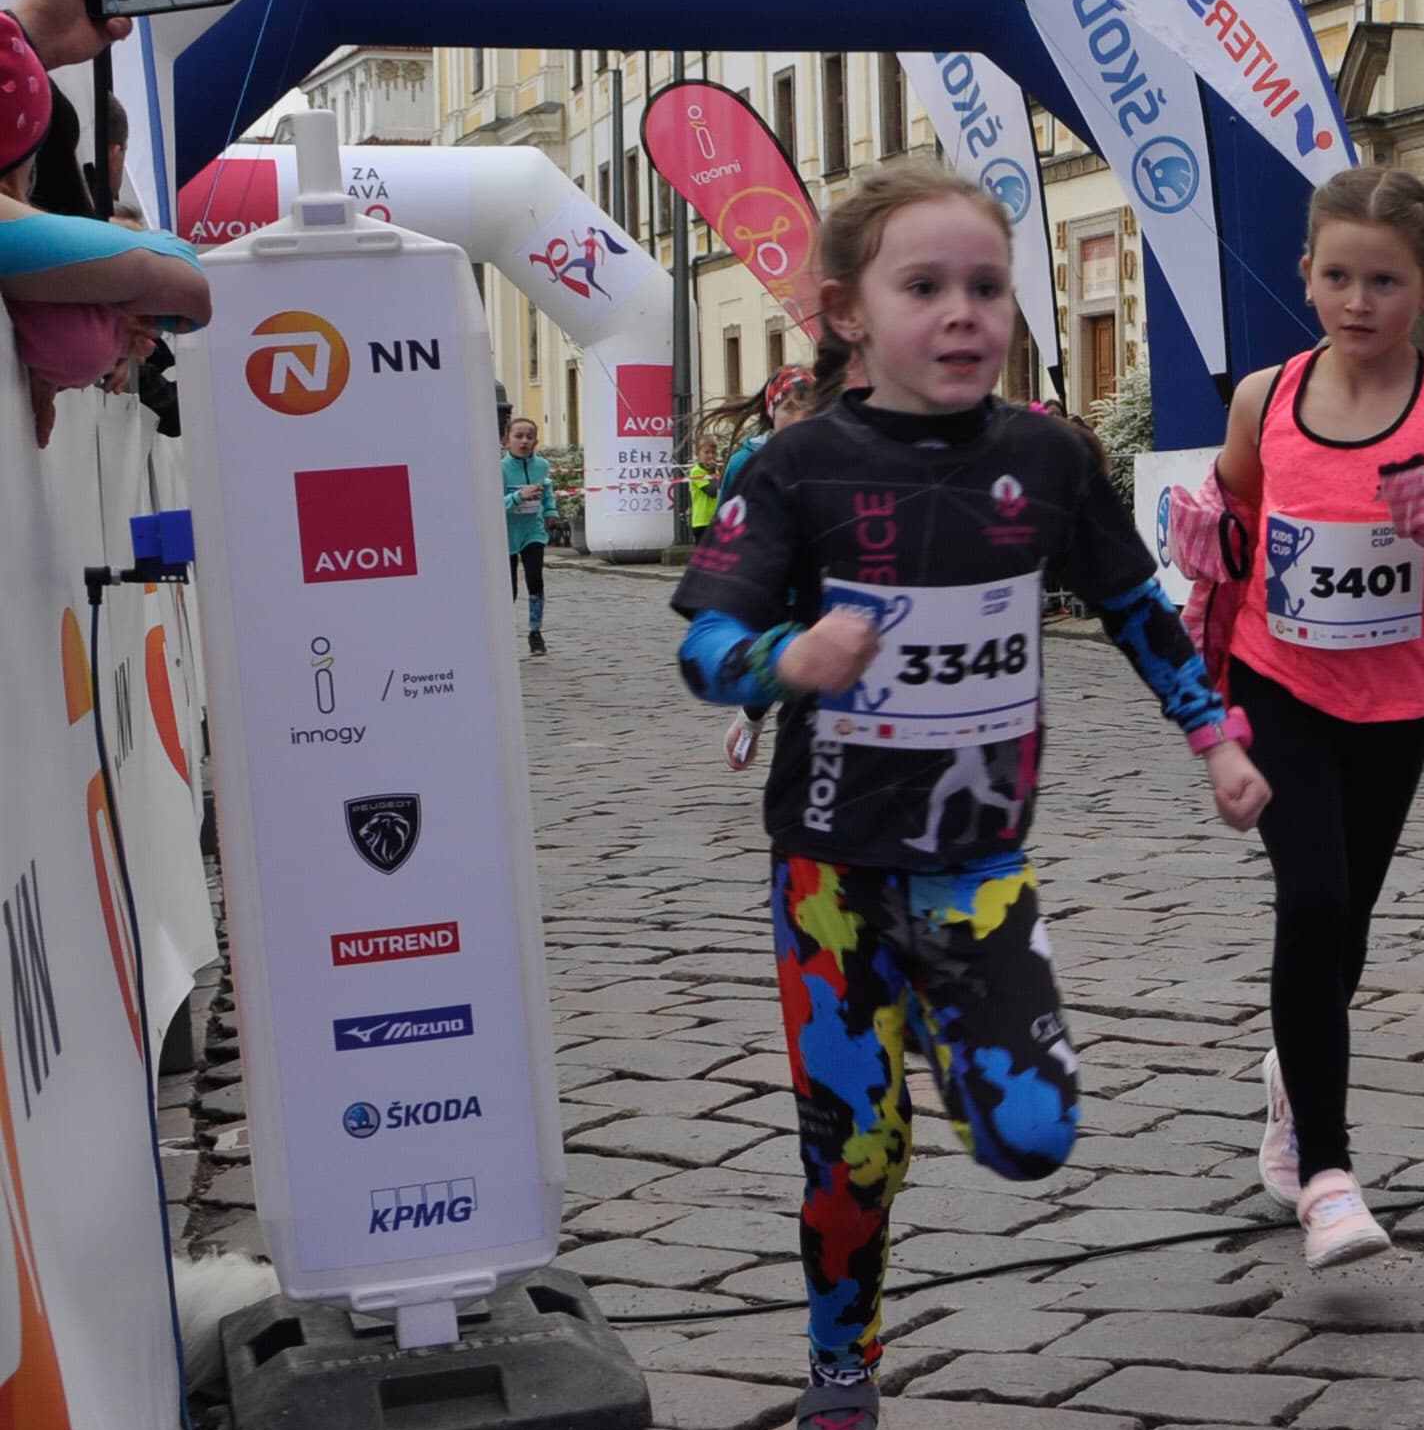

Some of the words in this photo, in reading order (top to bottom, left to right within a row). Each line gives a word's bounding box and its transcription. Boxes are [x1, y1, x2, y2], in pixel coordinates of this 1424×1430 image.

[352, 167, 380, 180] ZA
[347, 181, 389, 200] AVÁ
[368, 338, 441, 373] NN
[618, 497, 664, 512] 2023
[1271, 528, 1293, 544] KIDS
[314, 546, 403, 573] AVON
[1271, 543, 1291, 556] CUP
[1310, 561, 1412, 599] 3401
[897, 632, 1027, 685] 3348
[402, 670, 455, 685] Powered
[403, 686, 420, 699] by
[423, 682, 455, 695] MVM
[290, 722, 367, 747] innogy
[338, 929, 454, 959] NUTREND
[386, 1096, 482, 1130] ŠKODA
[368, 1195, 473, 1235] KPMG
